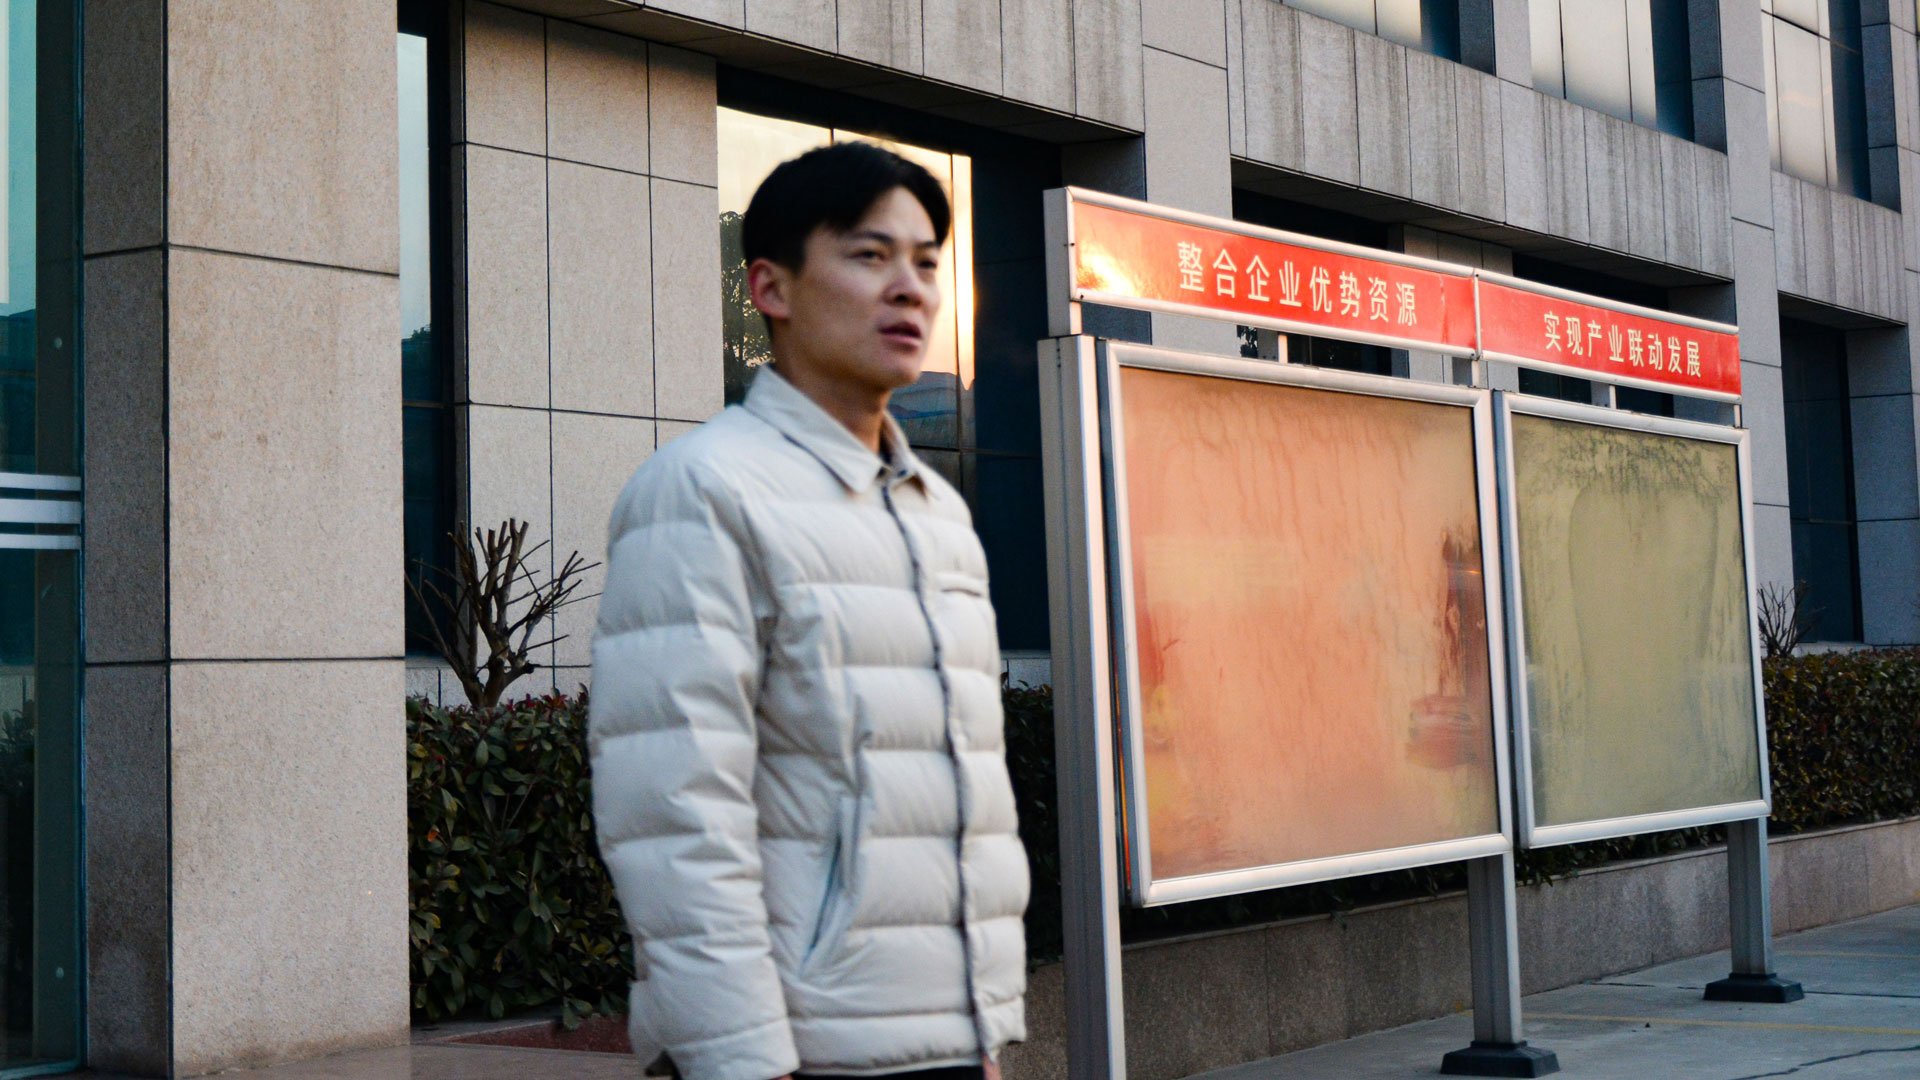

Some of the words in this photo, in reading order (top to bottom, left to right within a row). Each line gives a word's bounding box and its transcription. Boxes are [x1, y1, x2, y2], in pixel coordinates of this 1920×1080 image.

[1177, 241, 1418, 326] 整合企业优势资源
[1544, 311, 1702, 377] 实现产业联动发展
